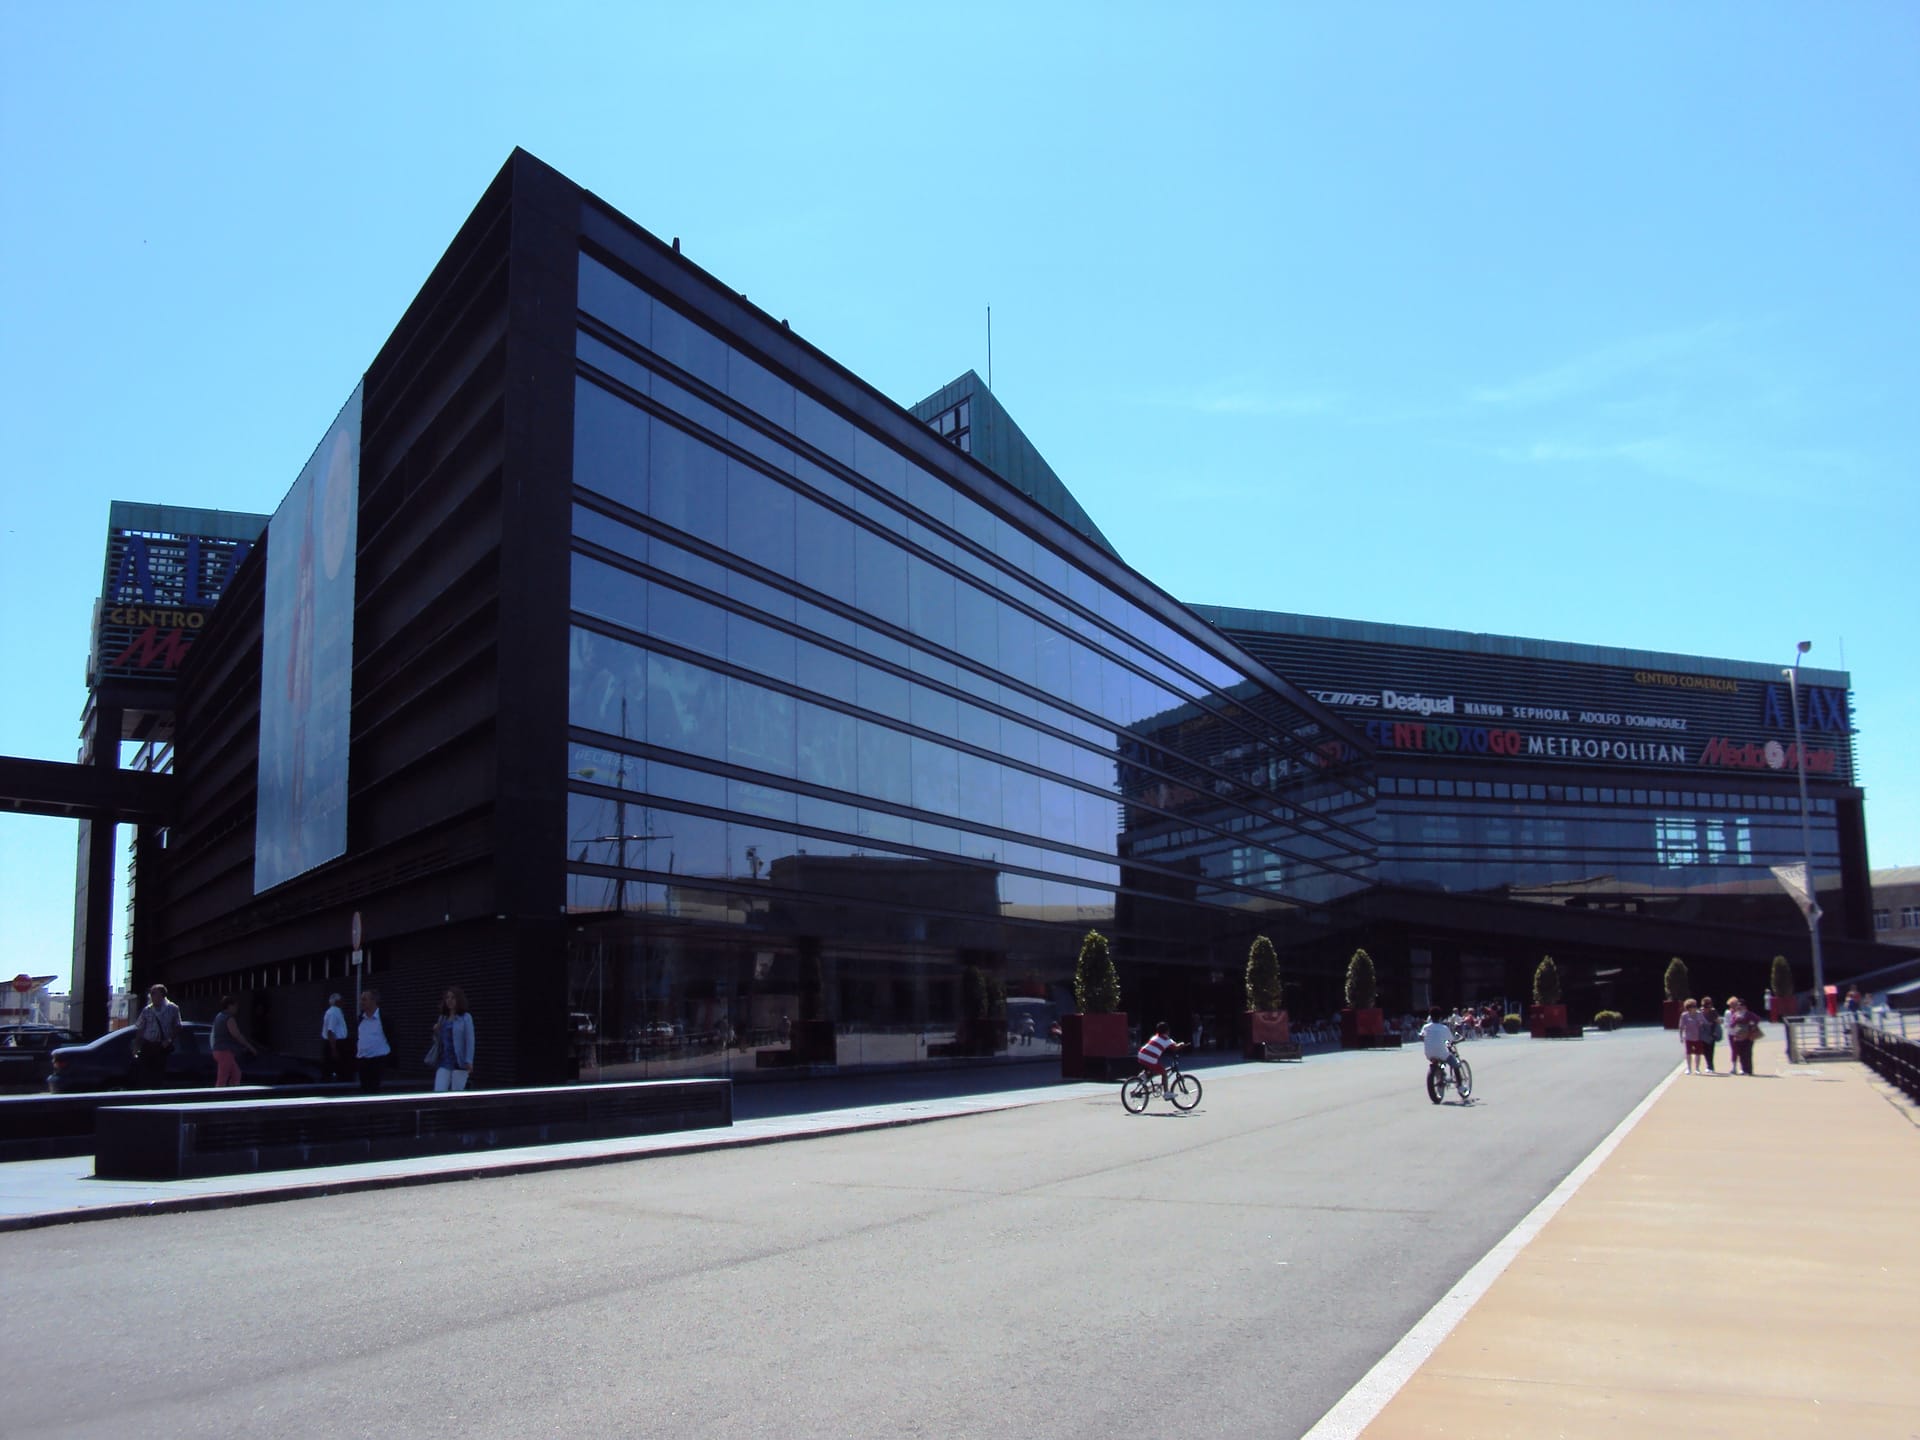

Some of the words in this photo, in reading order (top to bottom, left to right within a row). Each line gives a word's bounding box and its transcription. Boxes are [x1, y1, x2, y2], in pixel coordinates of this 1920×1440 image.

[110, 608, 204, 628] CENTRO
[1634, 671, 1677, 686] CENTRO
[1679, 675, 1739, 692] COMERCIAL
[1382, 689, 1454, 716] Desigual
[1463, 702, 1503, 717] MANGO
[1512, 706, 1570, 721] SEPHORA
[1579, 711, 1621, 725] ADOLFO
[1625, 714, 1688, 730] DOMINGUEZ
[1528, 735, 1686, 763] METROPOLITAN
[1698, 736, 1767, 769] Media
